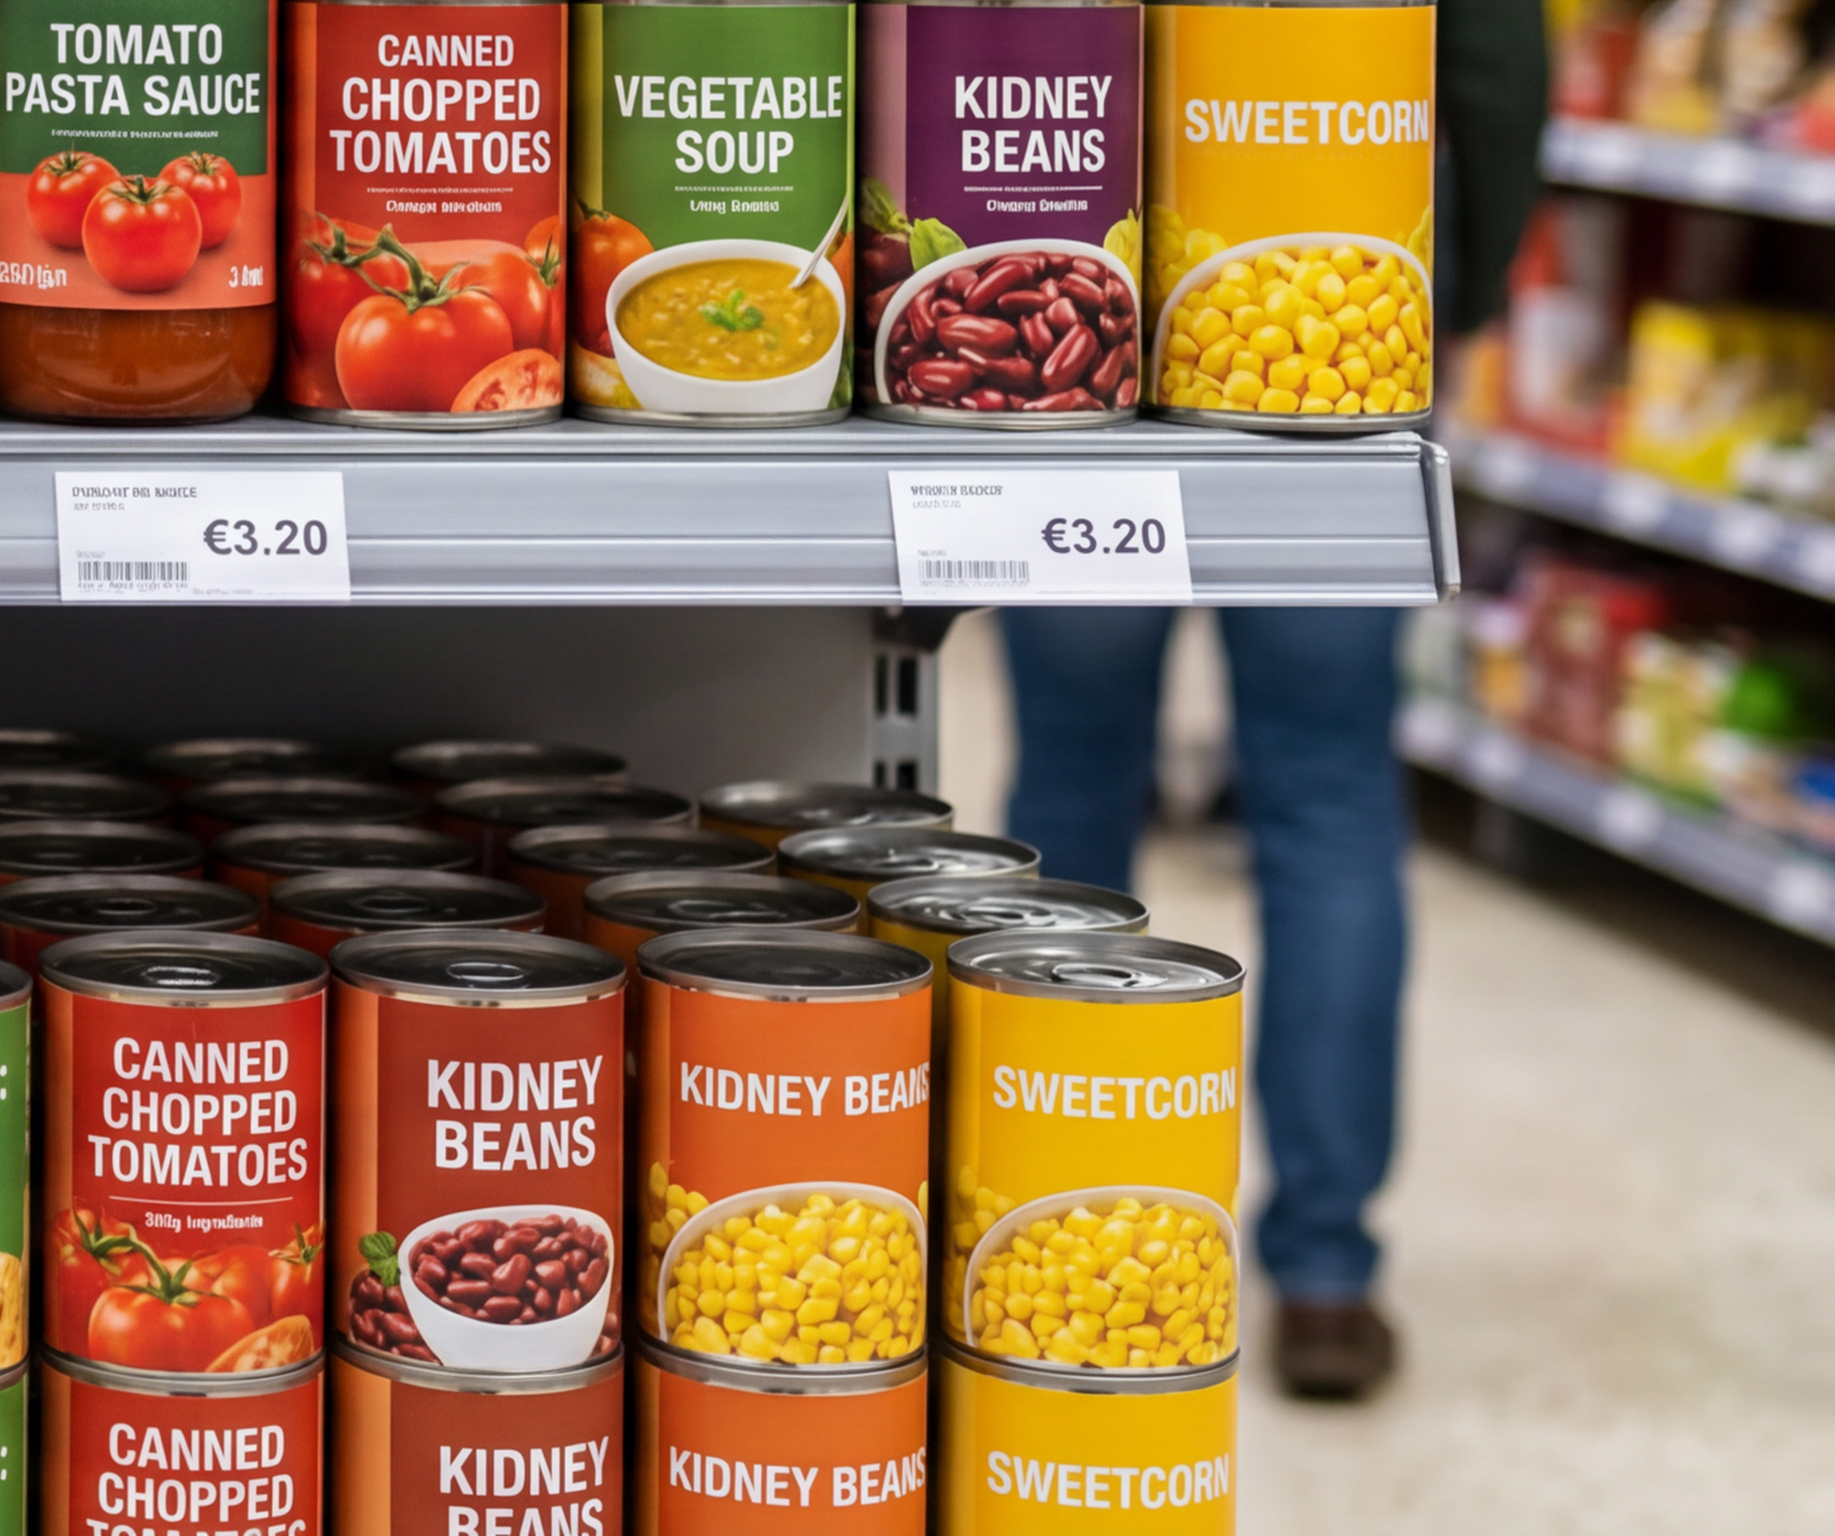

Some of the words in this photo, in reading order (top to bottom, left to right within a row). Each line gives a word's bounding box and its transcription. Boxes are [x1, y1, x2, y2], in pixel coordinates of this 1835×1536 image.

[50, 23, 223, 65] TOMATO
[378, 34, 514, 67] CANNED
[5, 72, 130, 115] PASTA
[144, 73, 260, 115] SAUCE
[342, 76, 540, 122] CHOPPED
[615, 75, 842, 119] VEGETABLE
[955, 75, 1112, 119] KIDNEY
[1185, 98, 1429, 144] SWEETCORN
[330, 129, 551, 174] TOMATOES
[675, 130, 794, 174] SOUP
[961, 129, 1106, 173] BEANS
[203, 519, 328, 556] €3.20
[1041, 517, 1166, 554] €3.20
[113, 1037, 288, 1084] CANNED
[427, 1055, 603, 1112] KIDNEY
[102, 1087, 297, 1136] CHOPPED
[681, 1061, 831, 1116] KIDNEY
[993, 1065, 1236, 1120] SWEETCORN
[87, 1134, 308, 1187] TOMATOES
[436, 1116, 596, 1171] BEANS
[108, 1422, 285, 1471] CANNED
[440, 1436, 609, 1496] KIDNEY
[98, 1472, 294, 1523] CHOPPED
[669, 1445, 818, 1507] KIDNEY
[832, 1446, 927, 1507] BEANS
[987, 1451, 1229, 1510] SWEETCORN
[448, 1498, 603, 1536] BEANS
